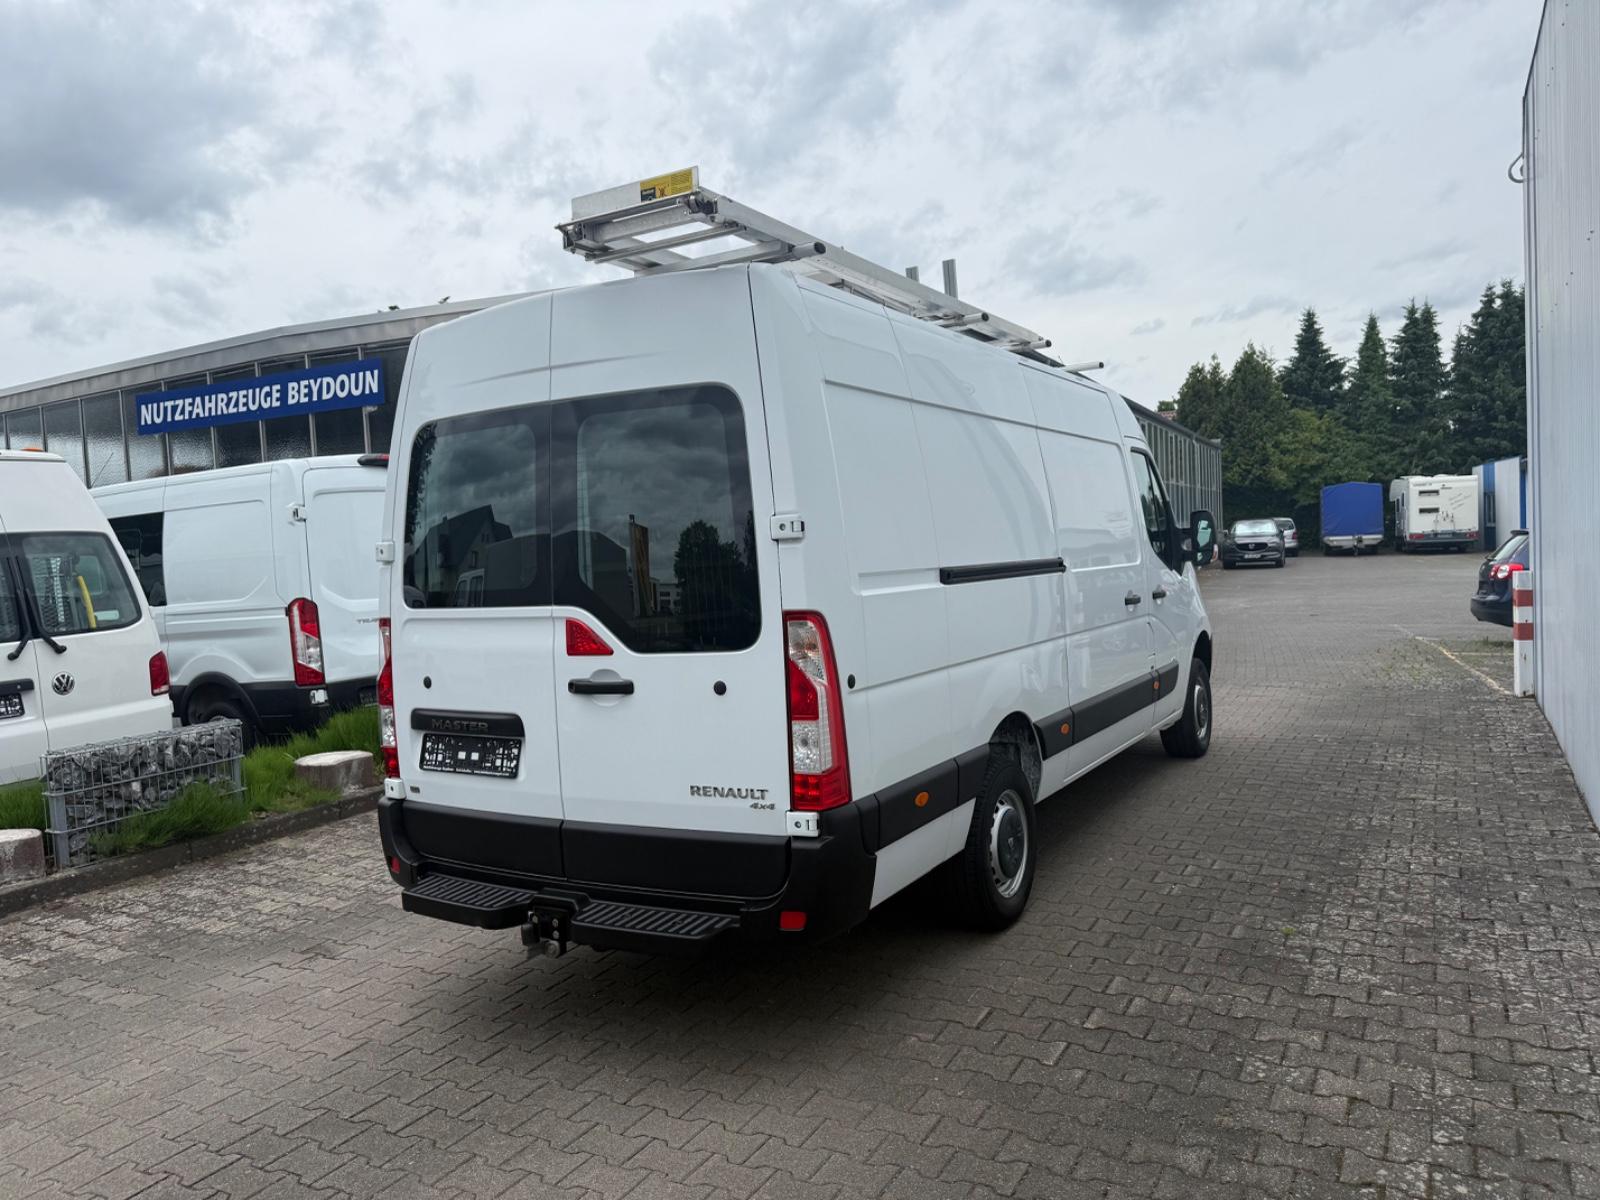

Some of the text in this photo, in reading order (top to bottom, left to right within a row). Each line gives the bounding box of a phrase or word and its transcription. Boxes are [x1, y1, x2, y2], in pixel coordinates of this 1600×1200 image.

[140, 369, 379, 426] NUTZFAHRZEUGE BEYDOUN
[431, 718, 488, 732] MASTER
[689, 785, 769, 800] RENAULT
[750, 802, 776, 810] 4x4
